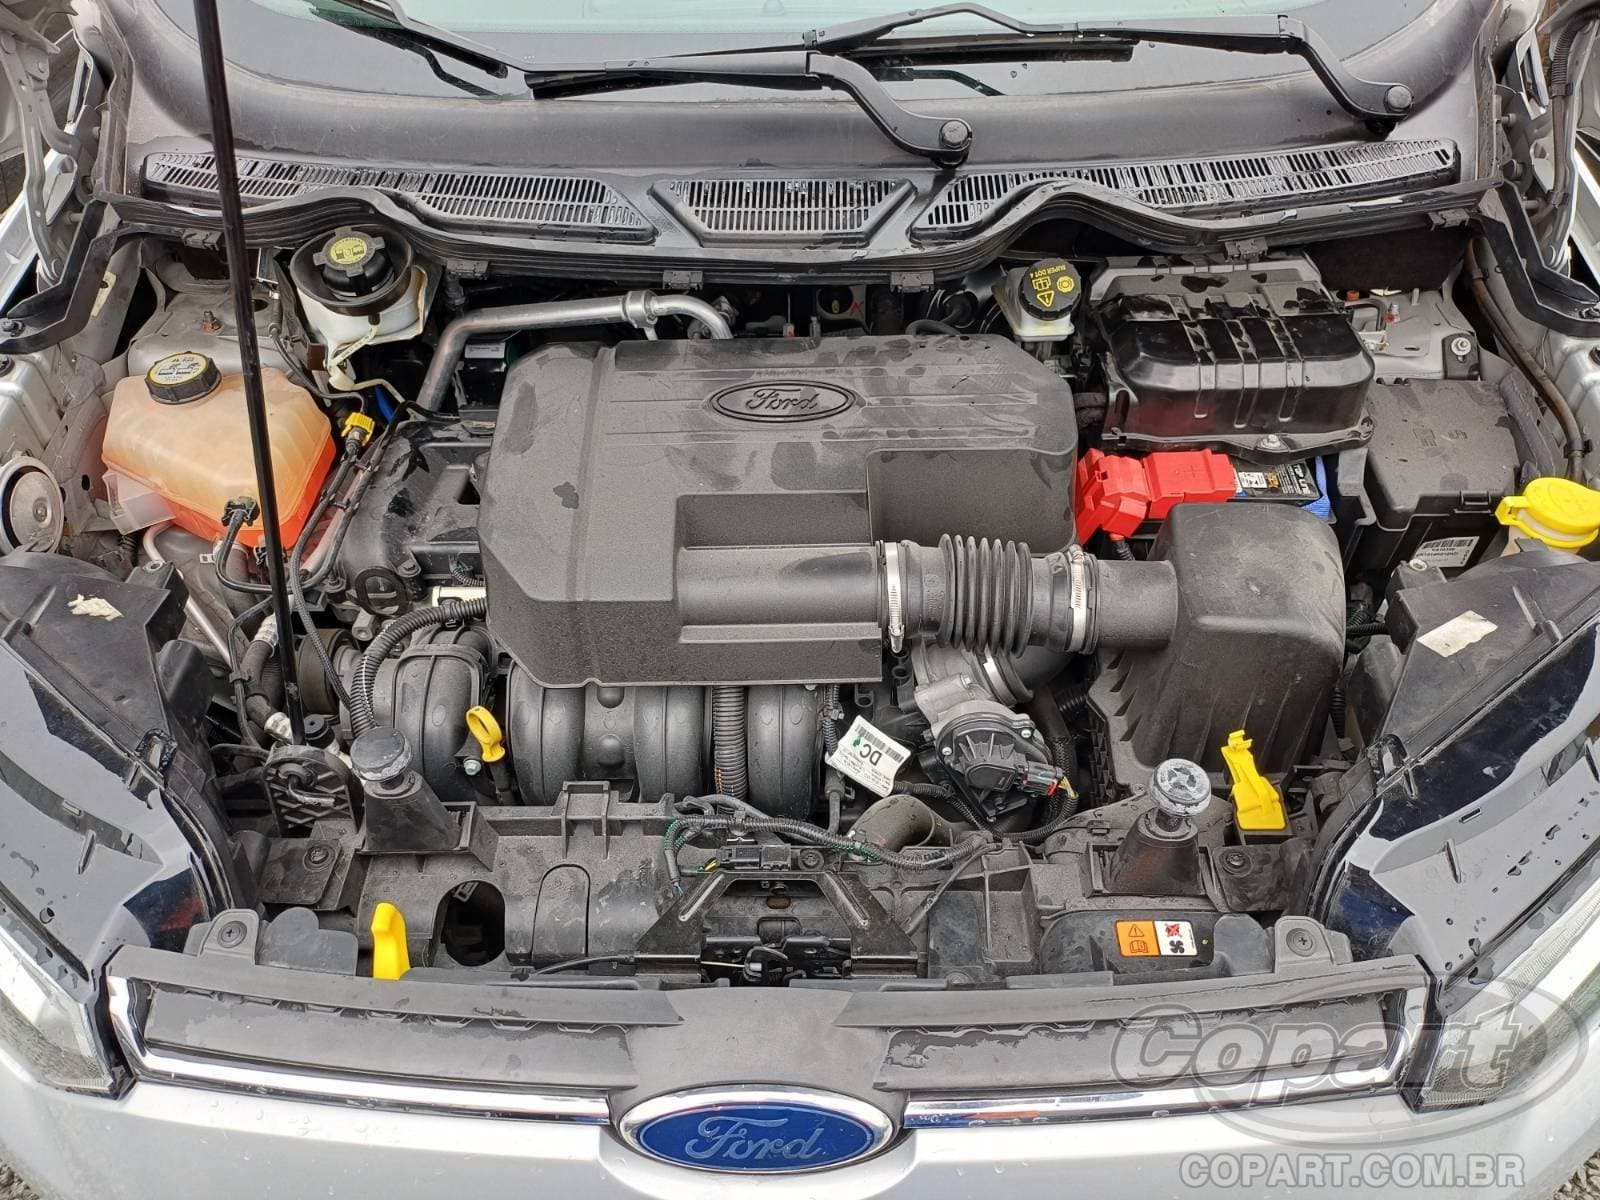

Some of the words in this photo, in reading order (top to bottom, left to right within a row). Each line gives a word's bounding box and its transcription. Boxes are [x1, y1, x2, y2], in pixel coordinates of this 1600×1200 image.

[1034, 269, 1047, 278] DOT
[1047, 264, 1067, 275] SUPER
[745, 388, 820, 410] Ford
[859, 743, 883, 767] DC
[684, 1115, 825, 1160] Ford
